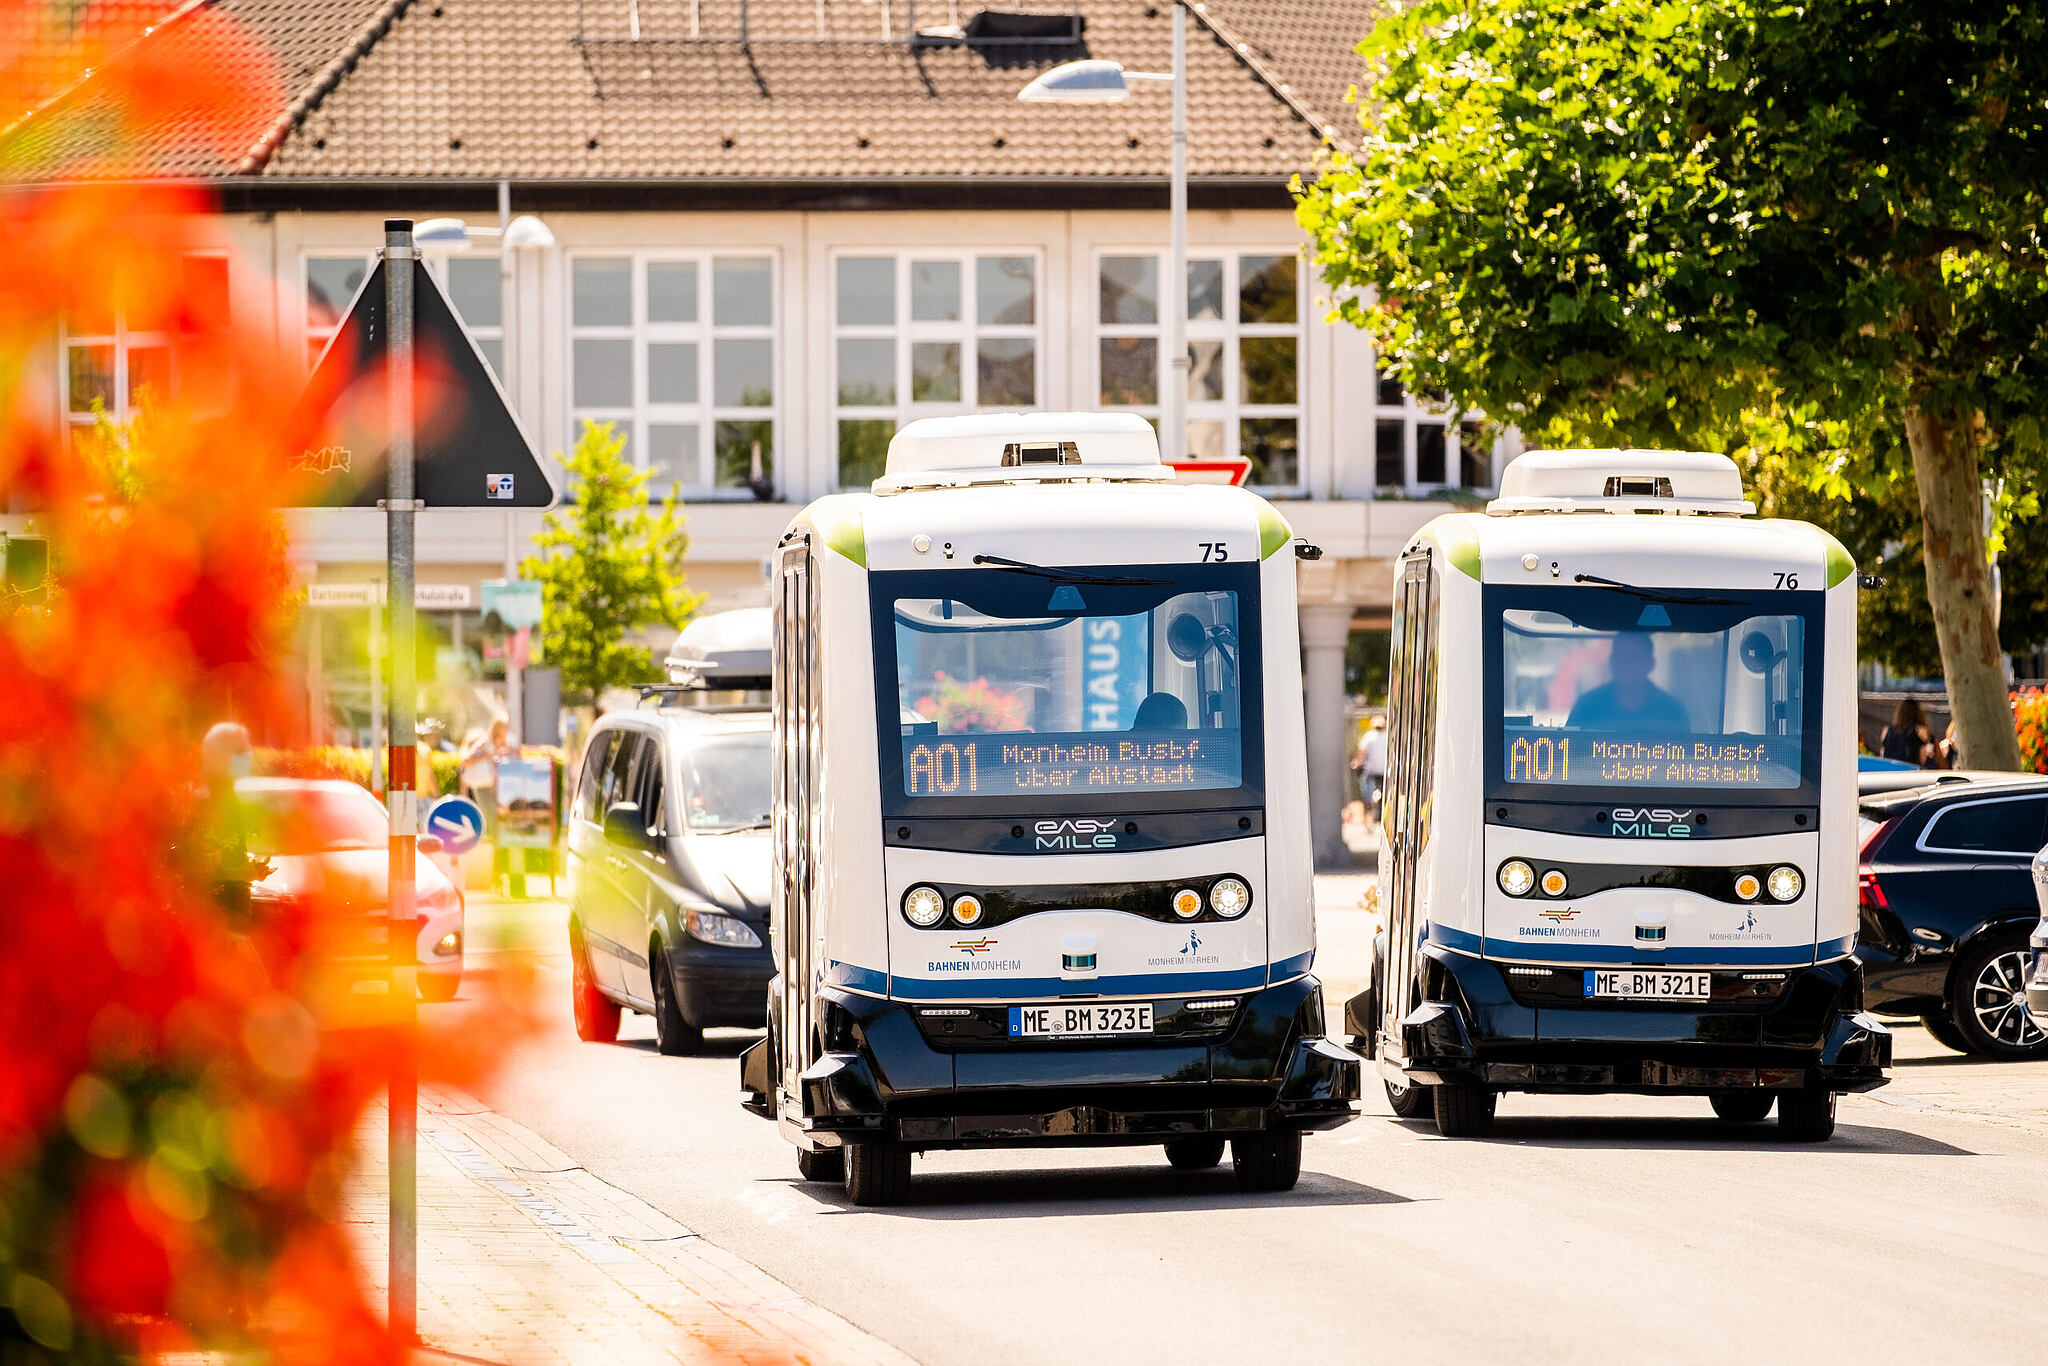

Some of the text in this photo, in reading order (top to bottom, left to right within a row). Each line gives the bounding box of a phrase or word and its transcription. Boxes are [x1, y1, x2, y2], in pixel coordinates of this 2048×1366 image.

[1199, 542, 1228, 563] 75
[1772, 572, 1799, 590] 76
[1088, 619, 1122, 729] HAUS
[1002, 740, 1206, 764] Monheim Busbf.
[1510, 736, 1569, 781] A01
[1592, 741, 1770, 762] Monheim Busbf.
[909, 743, 978, 793] A01
[1088, 764, 1196, 785] Altstadt
[1666, 763, 1760, 783] Altstadt
[1596, 974, 1709, 995] ME BM 321E
[1023, 1007, 1151, 1032] ME BM 323E
